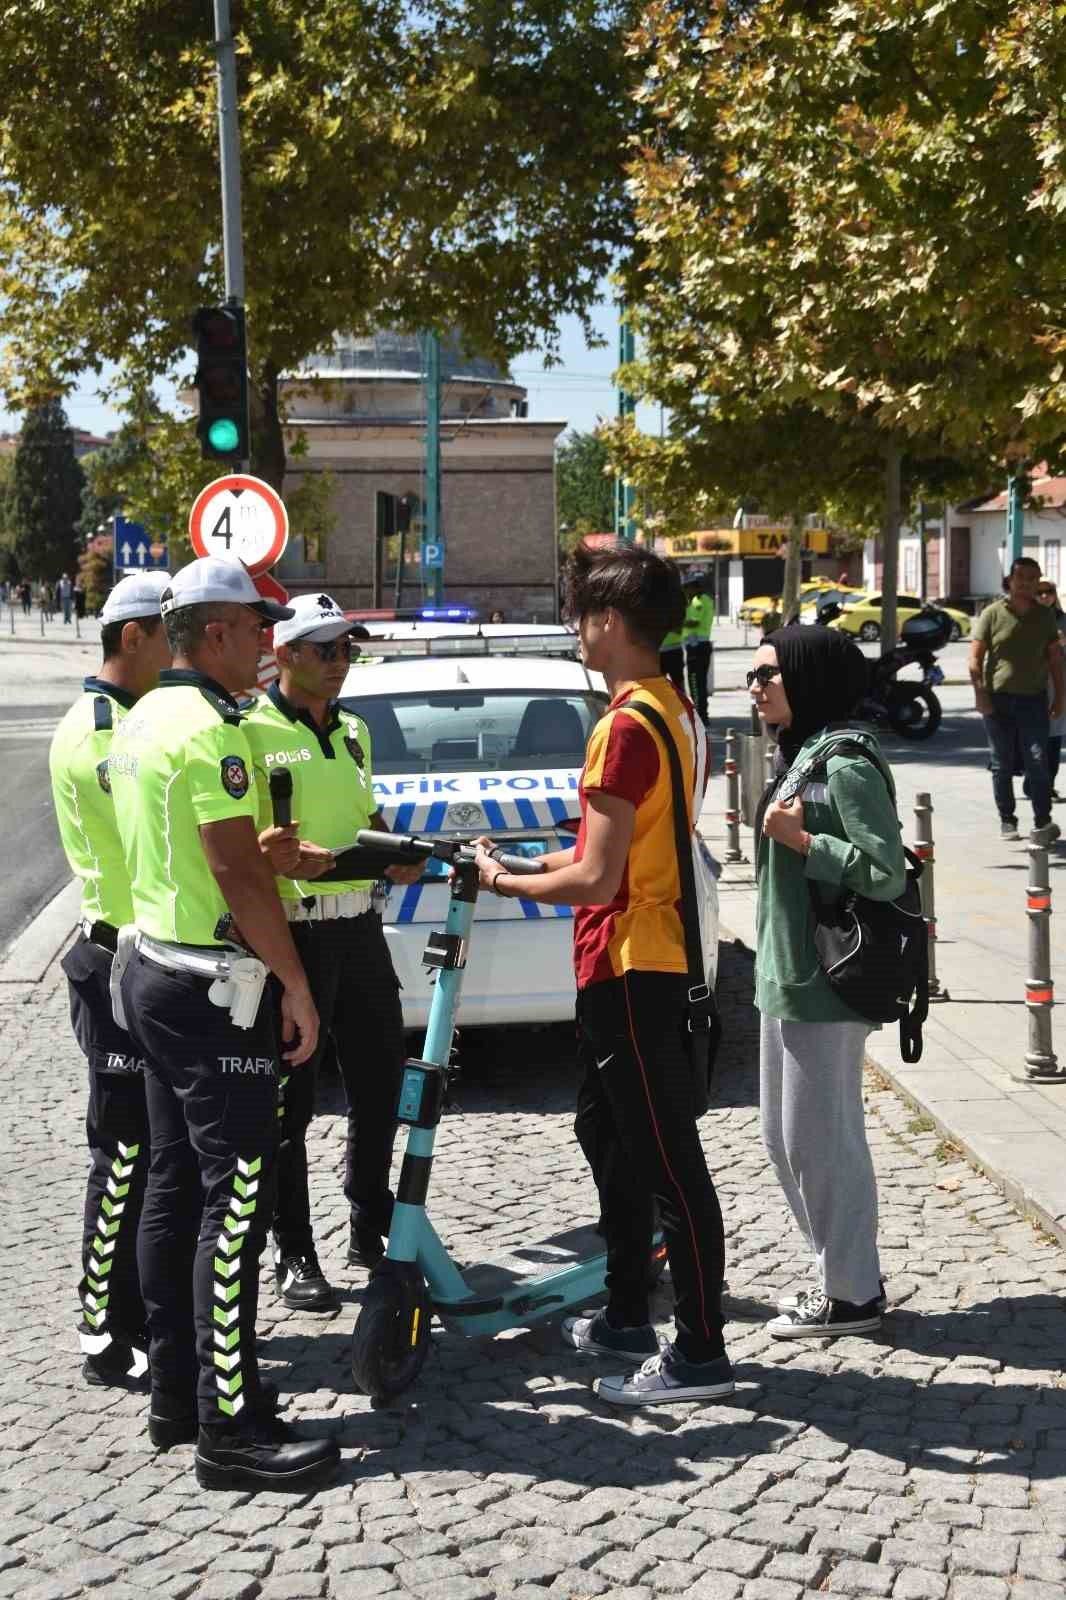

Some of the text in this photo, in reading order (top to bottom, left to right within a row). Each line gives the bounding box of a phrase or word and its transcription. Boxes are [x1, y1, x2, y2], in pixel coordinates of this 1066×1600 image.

[211, 506, 233, 550] 4
[425, 544, 440, 566] P
[371, 773, 578, 796] AFİK POLİ
[105, 1052, 146, 1073] TRAF
